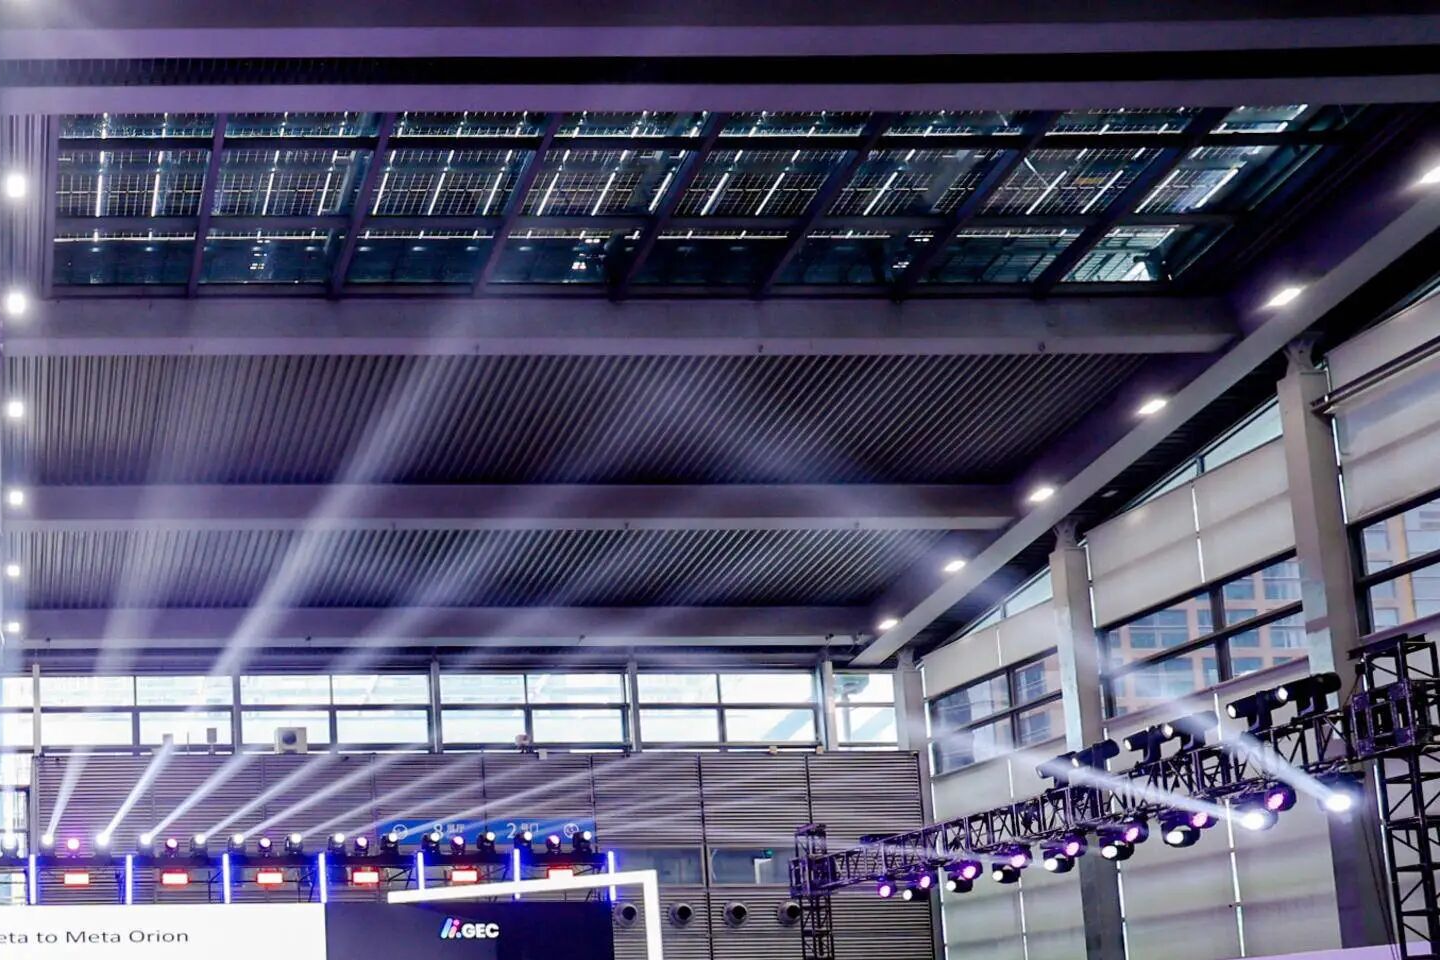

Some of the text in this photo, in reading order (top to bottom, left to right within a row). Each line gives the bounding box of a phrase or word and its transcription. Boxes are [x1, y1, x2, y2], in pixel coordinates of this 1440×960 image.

[506, 822, 516, 839] 2
[36, 931, 58, 945] to
[65, 930, 121, 944] Meta
[128, 929, 189, 944] Orion
